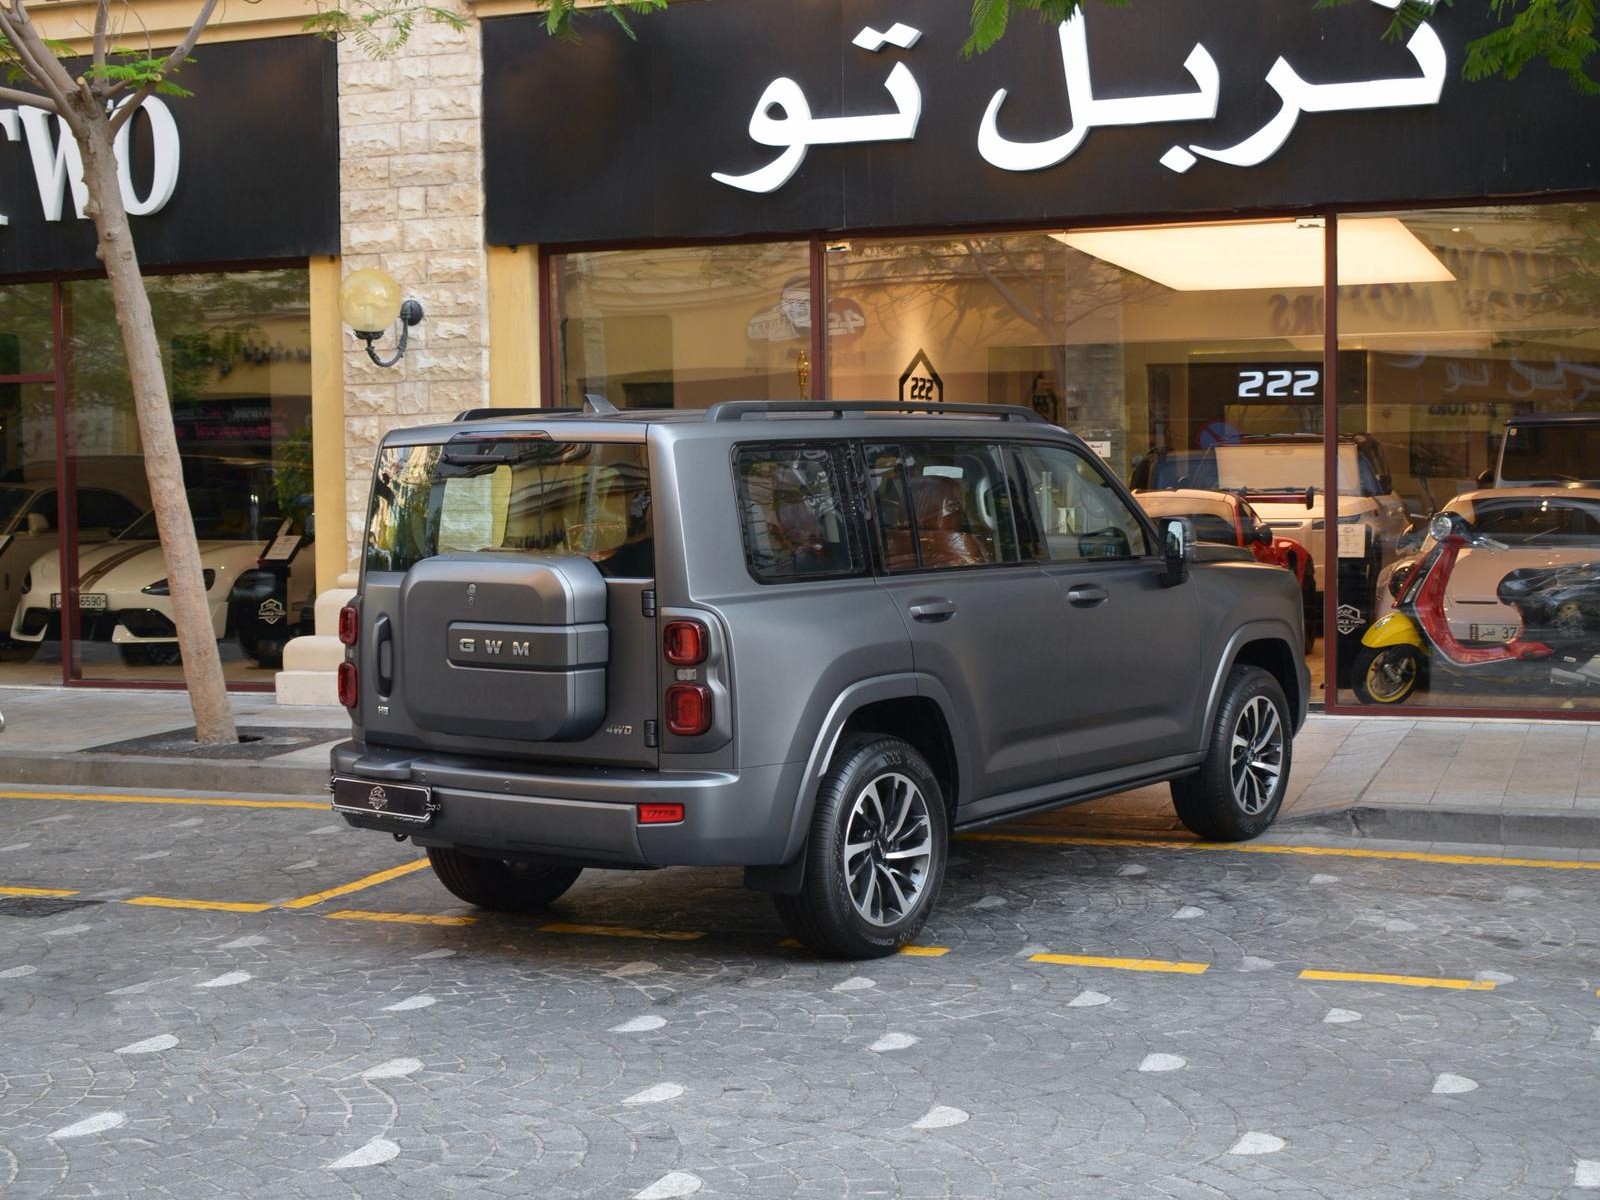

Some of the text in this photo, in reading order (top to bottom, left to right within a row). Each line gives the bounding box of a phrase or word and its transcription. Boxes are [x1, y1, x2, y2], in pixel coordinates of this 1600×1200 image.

[710, 22, 923, 193] تو
[910, 376, 934, 400] 222
[1238, 370, 1319, 397] 222
[459, 638, 530, 656] GWM
[605, 724, 633, 735] 4WD
